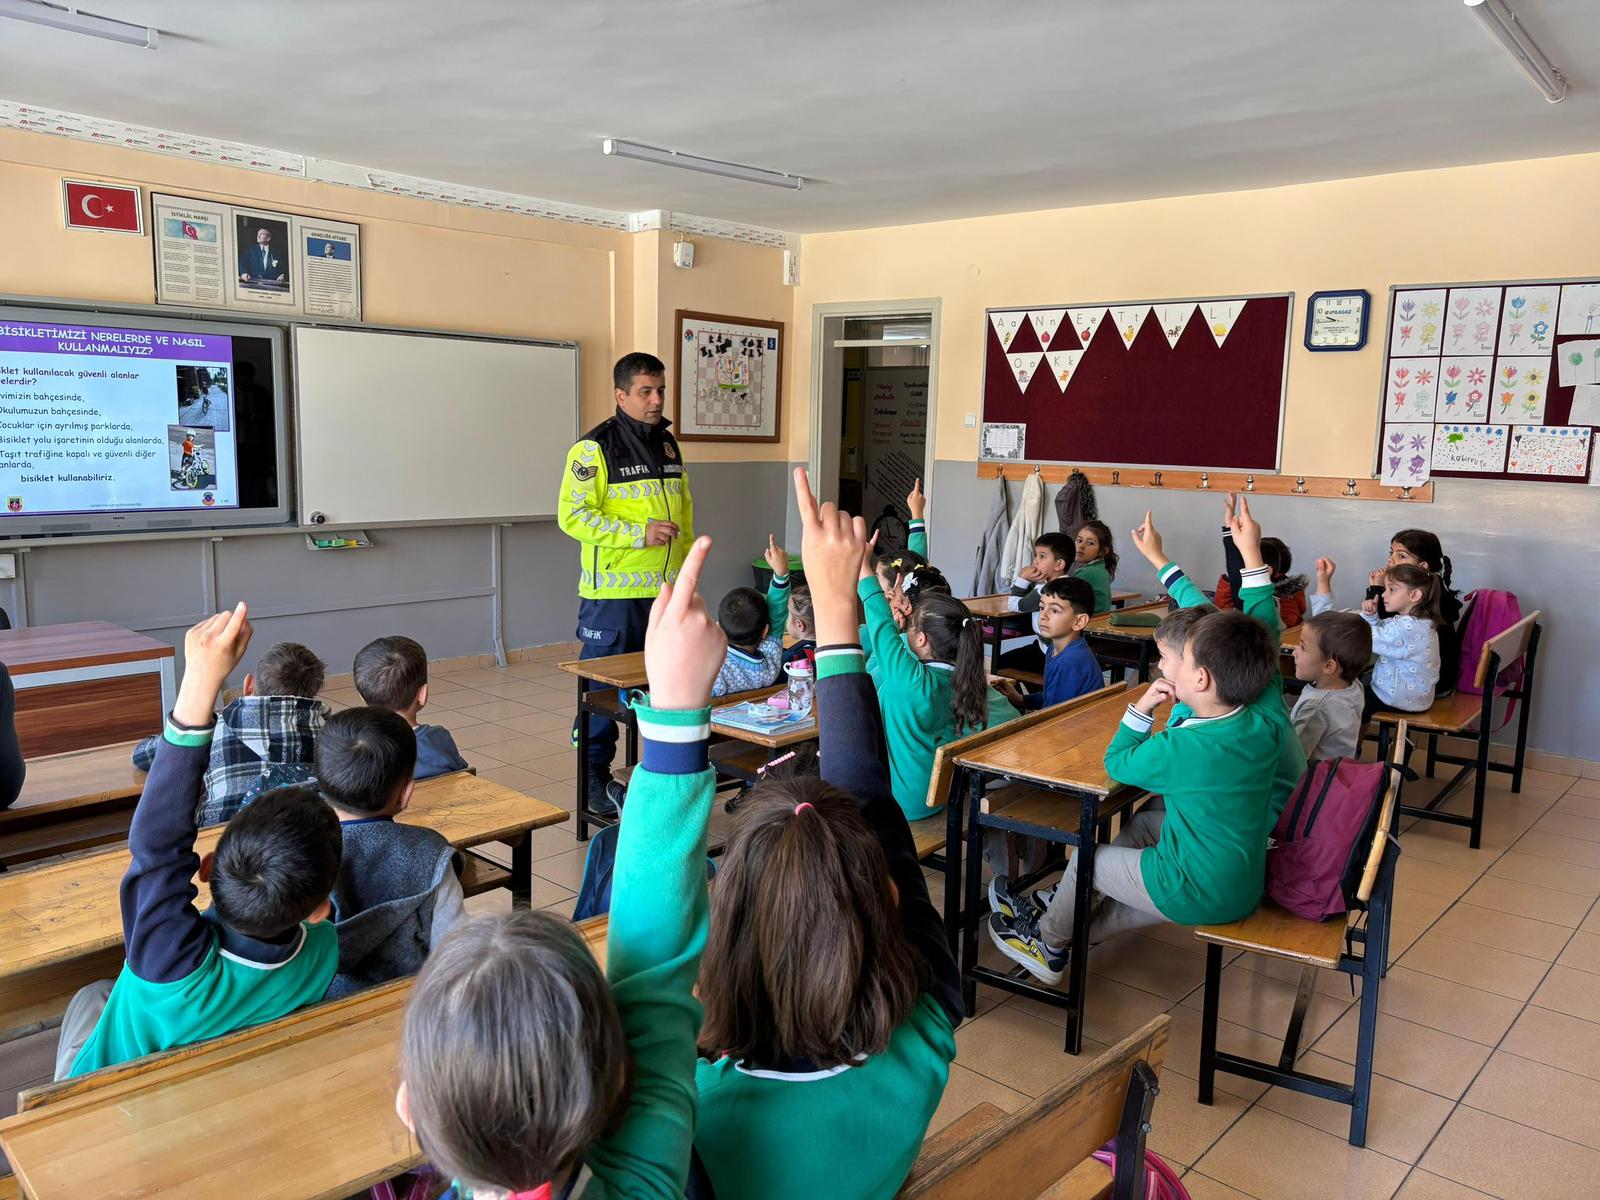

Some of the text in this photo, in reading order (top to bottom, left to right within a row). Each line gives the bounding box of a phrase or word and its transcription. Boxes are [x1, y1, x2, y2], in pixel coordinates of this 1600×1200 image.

[1118, 312, 1125, 322] T
[1211, 307, 1216, 319] L
[998, 318, 1004, 328] A
[1036, 316, 1044, 326] N
[1077, 314, 1083, 324] E
[91, 331, 151, 344] NERELERDE
[156, 336, 168, 345] VE
[172, 338, 205, 347] NASIL
[58, 342, 153, 355] KULLANMALIYIZ?
[1014, 358, 1022, 368] O
[1054, 355, 1074, 366] K k
[23, 368, 74, 376] kullanılacak
[78, 370, 107, 379] güvenli
[33, 392, 85, 402] bahçesinde,
[51, 407, 102, 416] bahçesinde,
[37, 422, 52, 430] için
[55, 422, 88, 431] ayrılmış
[91, 422, 133, 431] parklarda,
[33, 436, 51, 445] yolu
[54, 436, 94, 445] işaretinin
[96, 436, 123, 445] olduğu
[125, 436, 164, 445] alanlarda,
[24, 450, 63, 459] trafiğine
[66, 450, 90, 459] kapalı
[104, 450, 133, 459] güvenli
[135, 450, 156, 459] diğer
[58, 474, 116, 482] kullanabiliriz.
